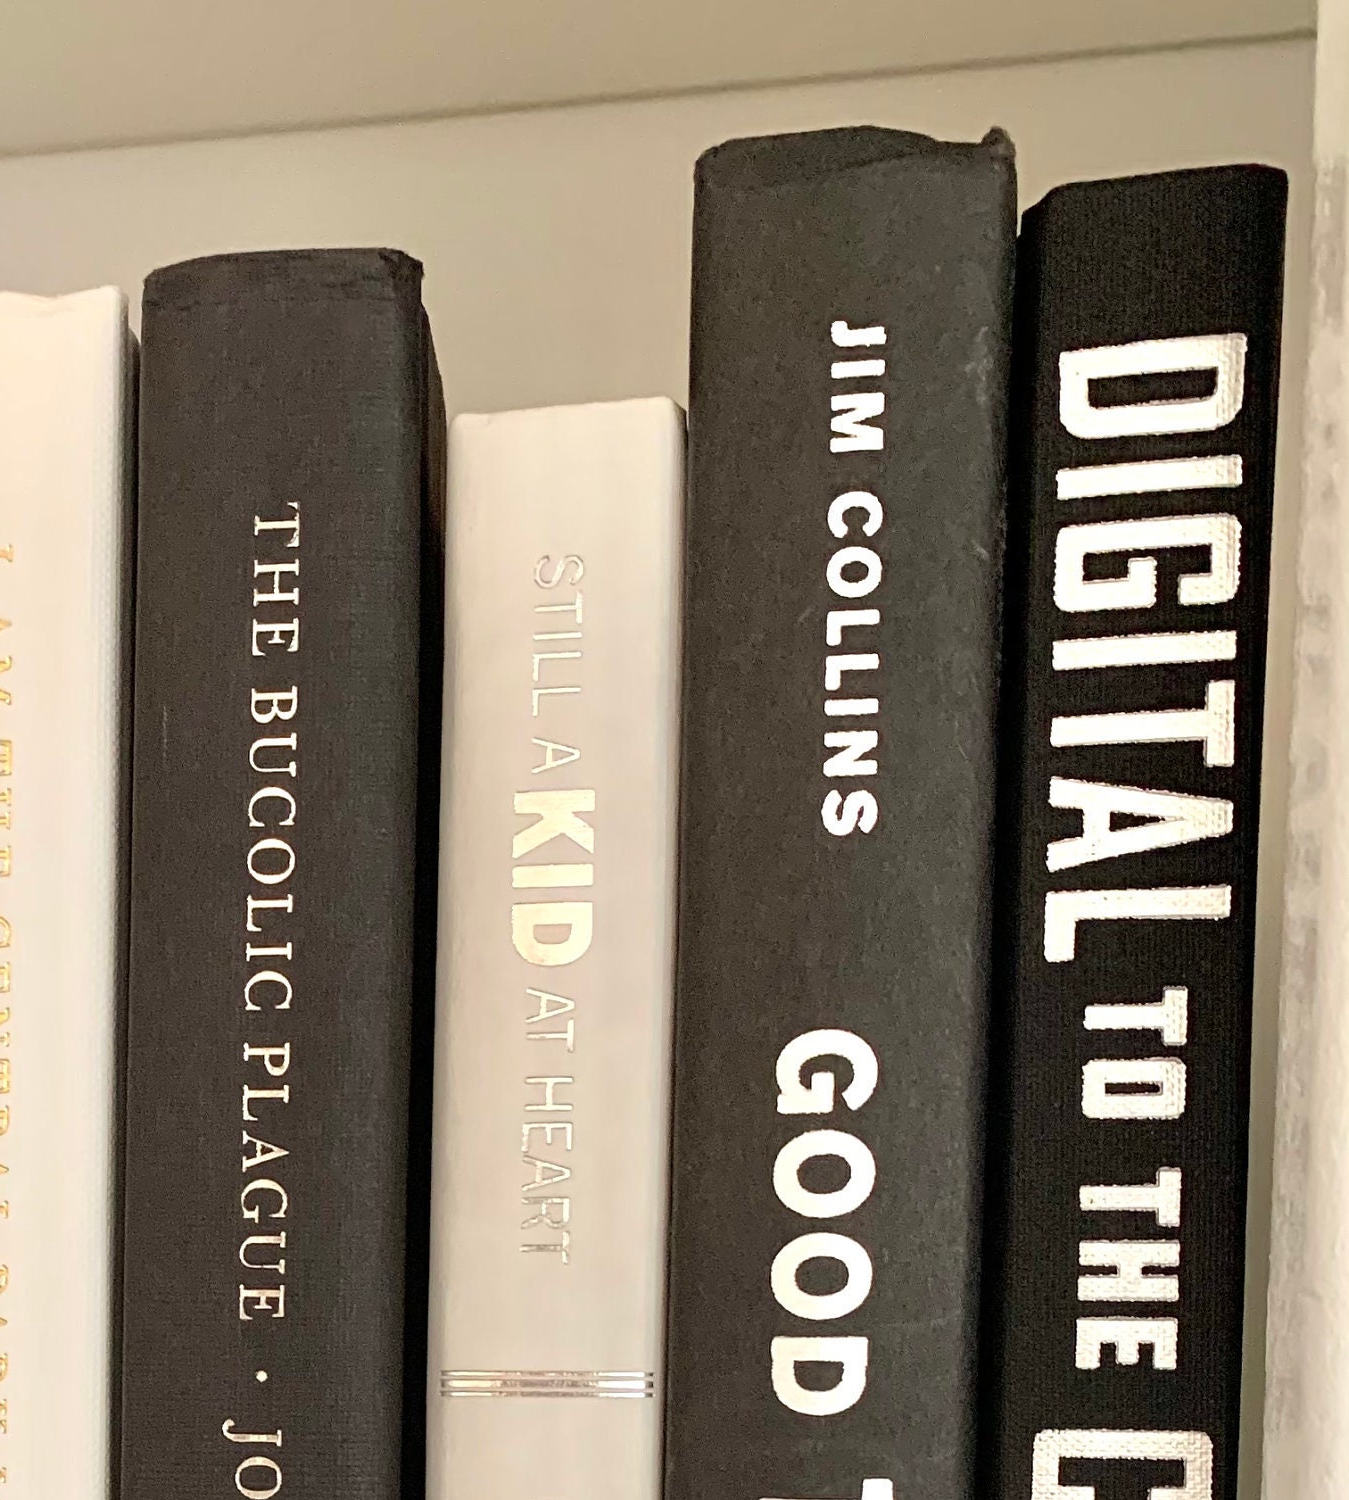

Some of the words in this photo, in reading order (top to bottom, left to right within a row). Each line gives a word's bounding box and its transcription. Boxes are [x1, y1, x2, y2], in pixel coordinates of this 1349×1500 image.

[830, 320, 887, 454] JIM
[250, 501, 300, 656] THE
[531, 555, 585, 718] STILL
[822, 490, 883, 836] COLLINS
[1043, 332, 1249, 963] DIGITAL
[530, 737, 582, 774] A
[243, 685, 299, 1011] BUCOLIC
[511, 789, 596, 967] KID
[525, 988, 578, 1053] AT
[1081, 986, 1188, 1121] TO
[238, 1042, 291, 1320] PLAGUE
[519, 1074, 576, 1265] HEART
[770, 1028, 879, 1417] GOOD
[1074, 1167, 1183, 1370] THE
